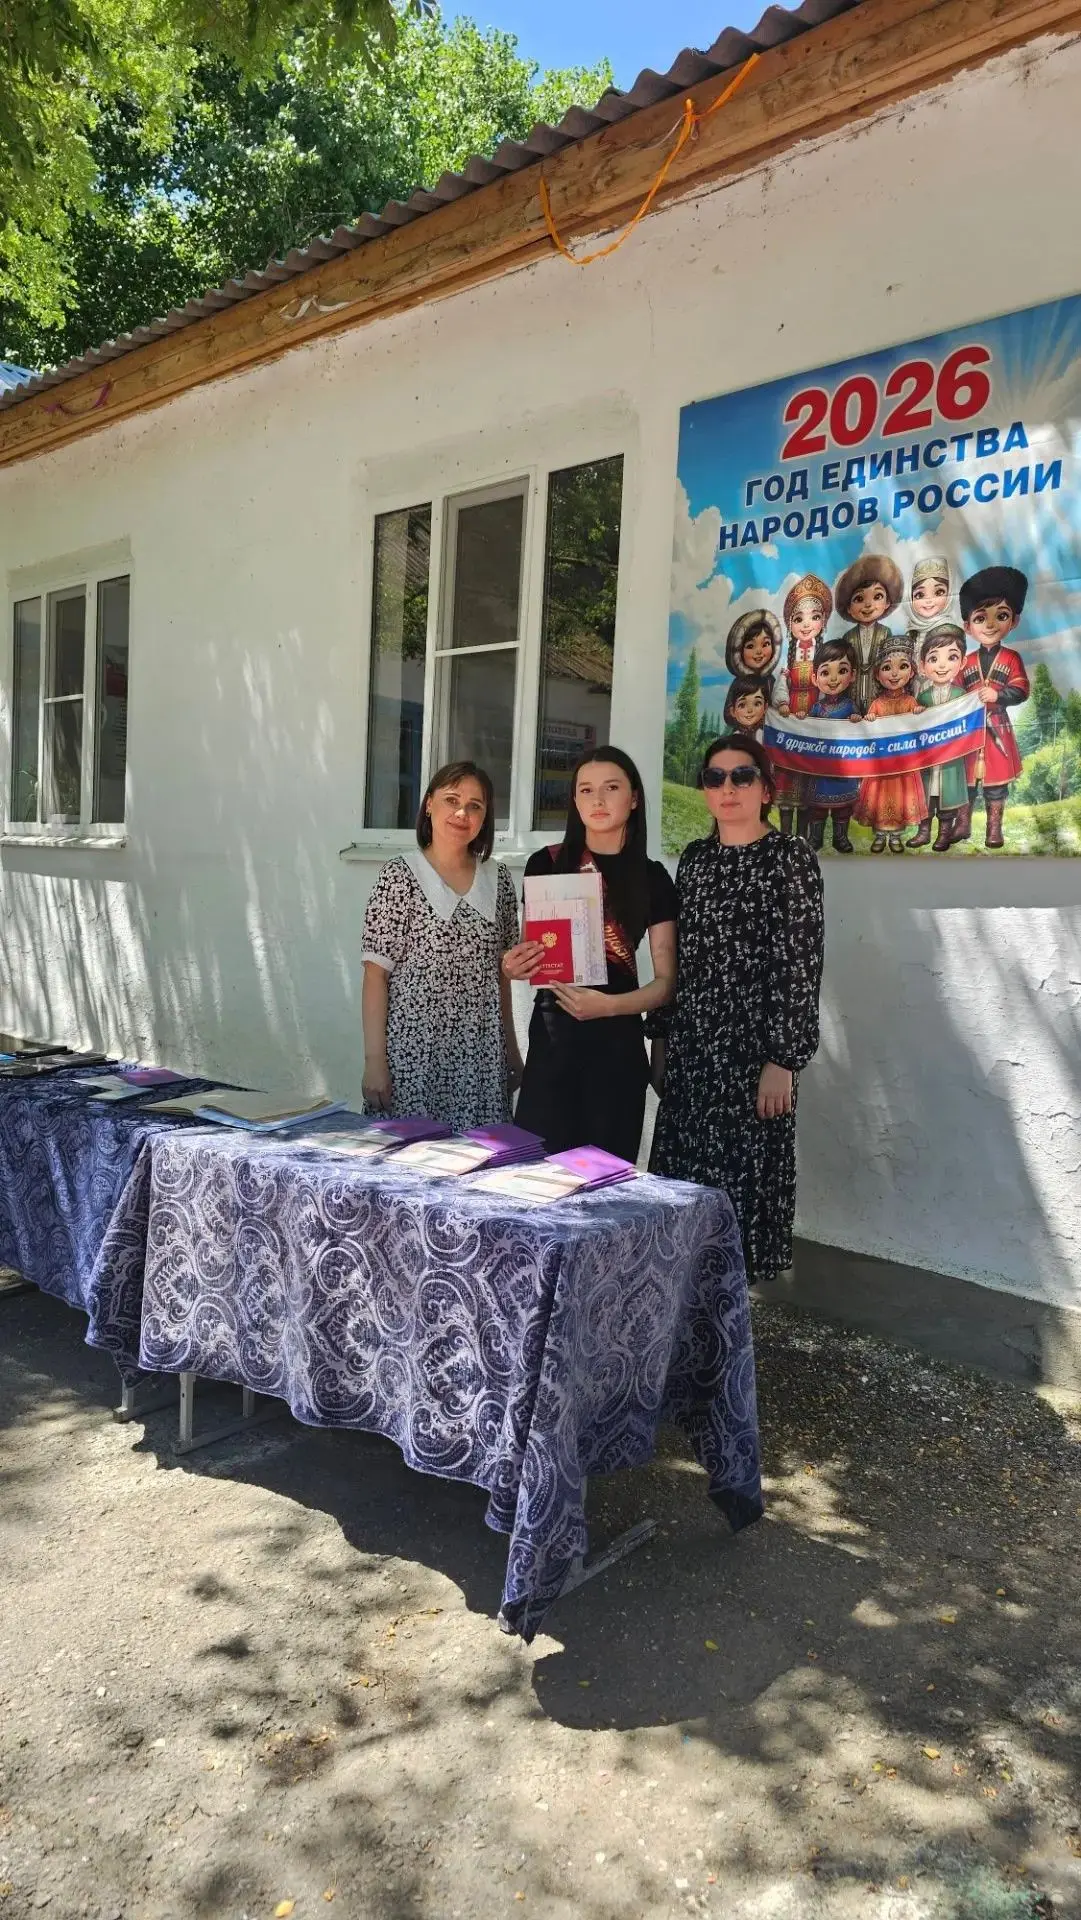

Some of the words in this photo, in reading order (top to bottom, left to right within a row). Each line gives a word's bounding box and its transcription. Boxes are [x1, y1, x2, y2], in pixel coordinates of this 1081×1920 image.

[781, 345, 991, 460] 2026
[718, 496, 879, 551] НАРОДОВ
[893, 459, 1063, 519] РОССИИ
[745, 468, 809, 507] ГОД
[821, 421, 1029, 493] ЕДИНСТВА
[776, 732, 785, 744] В
[785, 738, 828, 754] дружбе
[829, 741, 877, 758] народов
[887, 738, 917, 753] сила
[919, 719, 967, 746] России!
